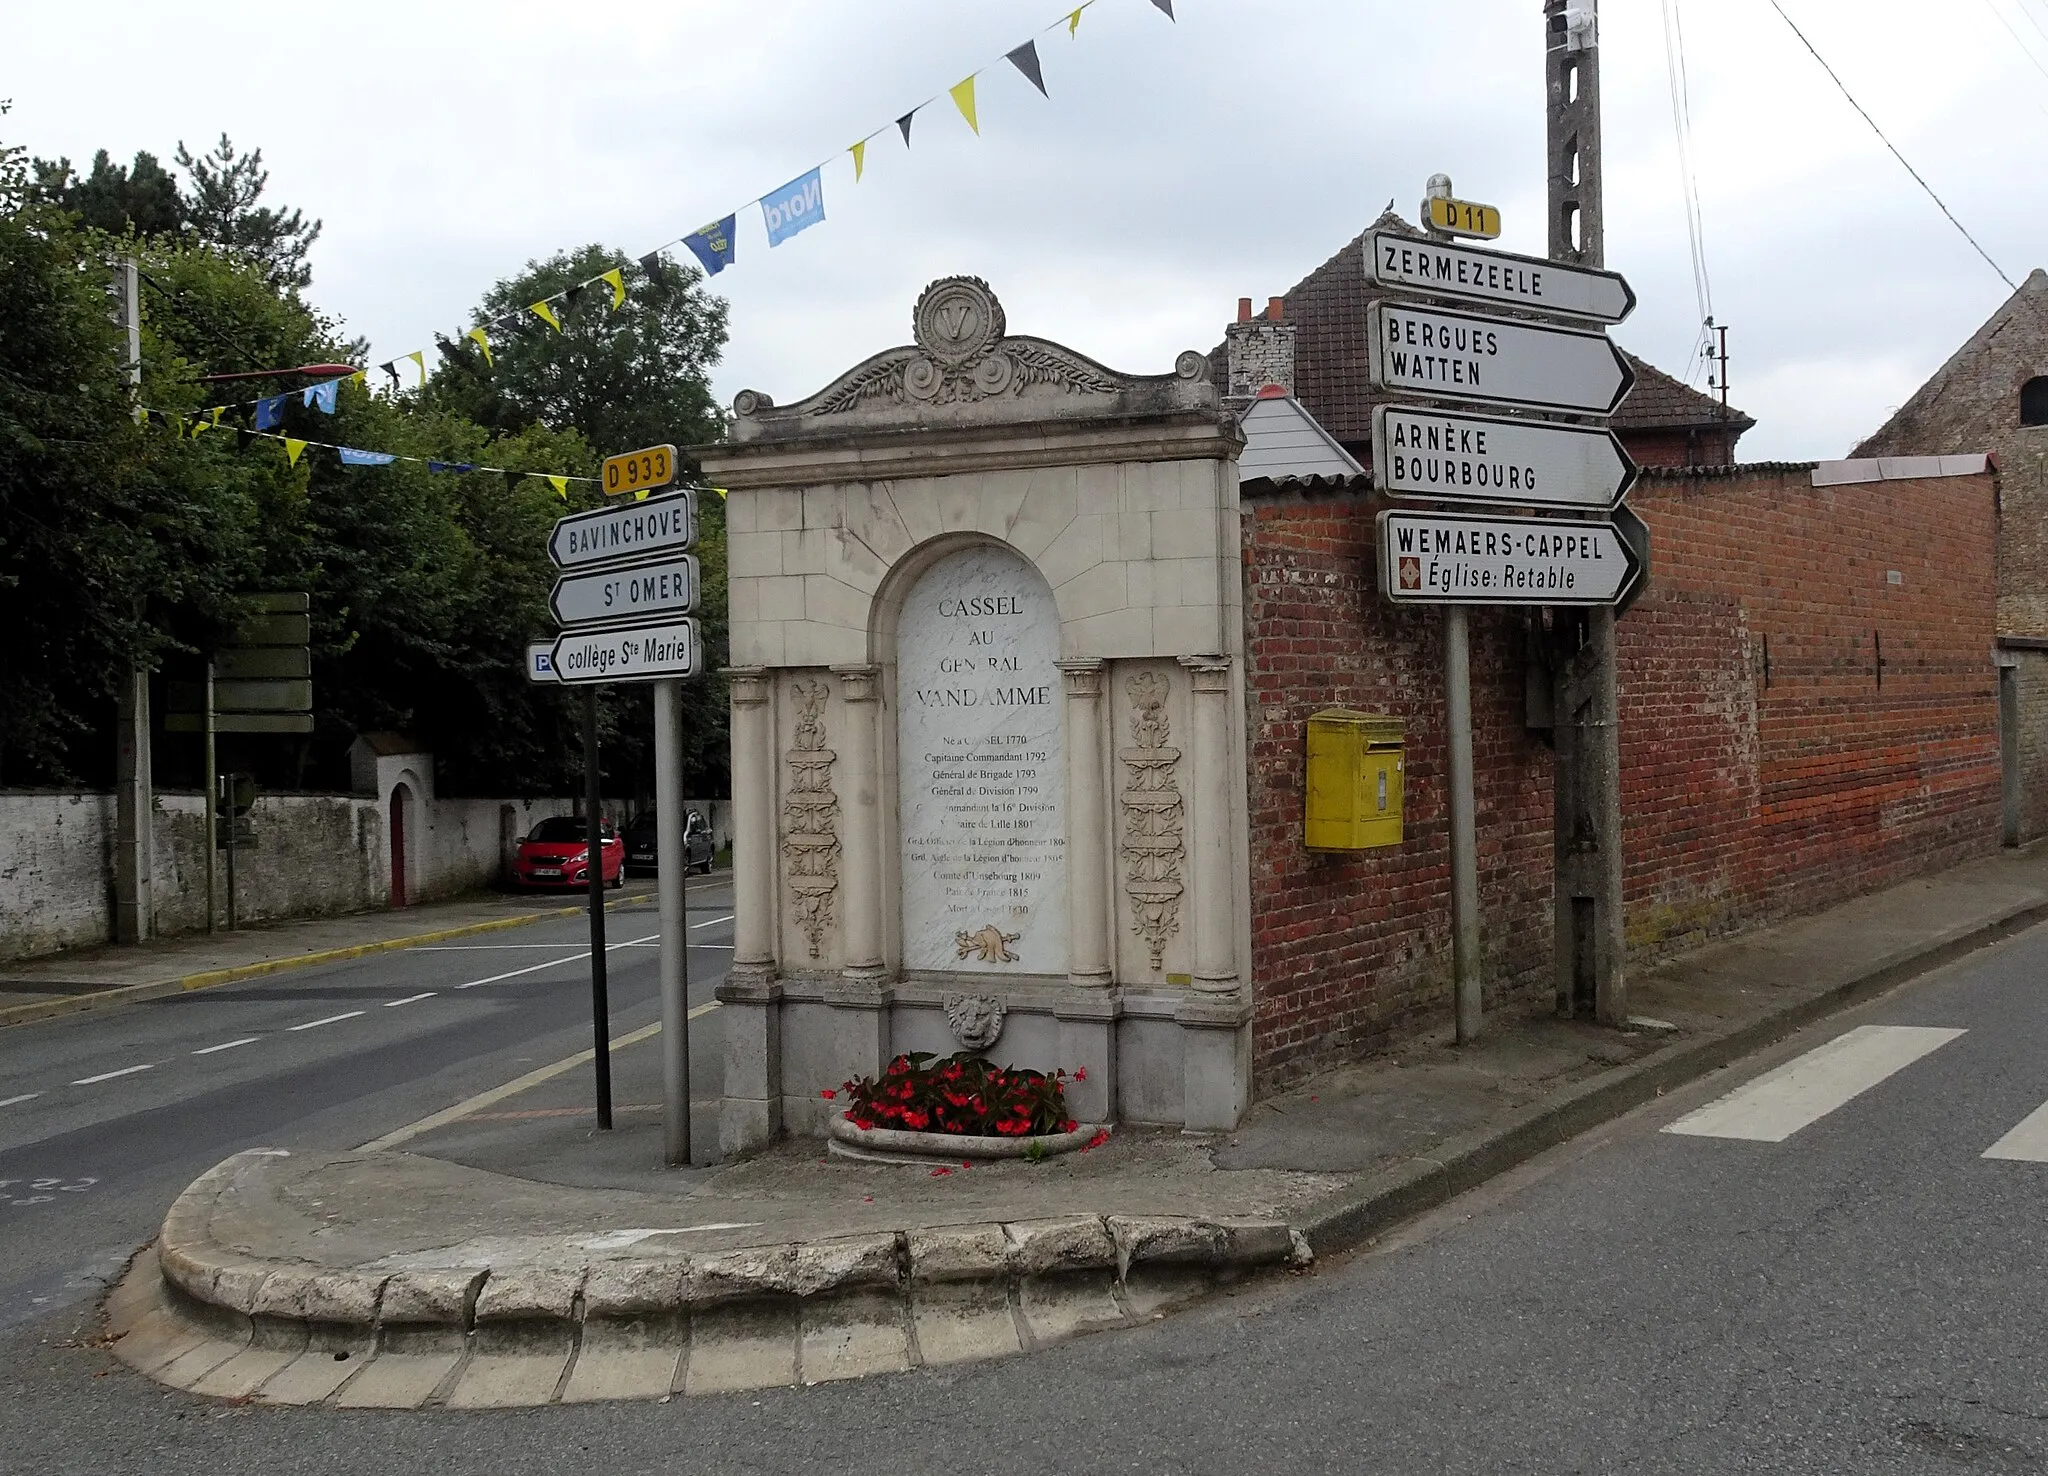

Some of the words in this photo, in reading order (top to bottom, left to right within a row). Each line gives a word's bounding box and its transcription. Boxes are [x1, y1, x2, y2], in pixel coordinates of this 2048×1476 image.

[1446, 203, 1458, 226] D
[1465, 206, 1486, 232] 11
[1385, 247, 1542, 296] ZERMEZEELE
[1389, 318, 1498, 356] BERGUES
[1391, 352, 1480, 385] WATTEN
[1394, 422, 1487, 455] ARNÈKE
[609, 465, 620, 488] D
[628, 453, 666, 484] 933
[1394, 456, 1536, 490] BOURBOURG
[570, 508, 682, 554] BAVINCHOVE
[1397, 528, 1602, 560] WEMAERS-CAPPEL
[1429, 555, 1498, 593] Église:
[1504, 565, 1575, 589] Retable
[630, 573, 683, 603] OMER
[938, 597, 1023, 617] CASSEL
[968, 631, 994, 646] AU
[568, 645, 615, 673] collège
[621, 641, 639, 664] Ste
[644, 636, 685, 663] Marie
[917, 687, 1051, 707] VANDAMME
[1006, 736, 1027, 744] 1770
[924, 753, 964, 764] Capitaine
[966, 752, 1022, 762] Commandant
[1025, 752, 1046, 761] 1792
[932, 770, 965, 780] Général
[967, 770, 978, 779] de
[980, 769, 1013, 780] Brigade
[1016, 769, 1036, 778] 1793
[931, 785, 964, 796] Général
[979, 786, 1015, 796] Division
[1018, 786, 1039, 795] 1799
[991, 803, 999, 812] la
[1019, 803, 1055, 812] Division
[991, 819, 1011, 829] Lille
[1013, 819, 1033, 829] 1801
[969, 837, 976, 846] la
[978, 837, 1005, 848] Légion
[963, 853, 971, 862] la
[973, 853, 1000, 864] Légion
[1020, 872, 1041, 881] 1809
[1008, 888, 1029, 897] 1815
